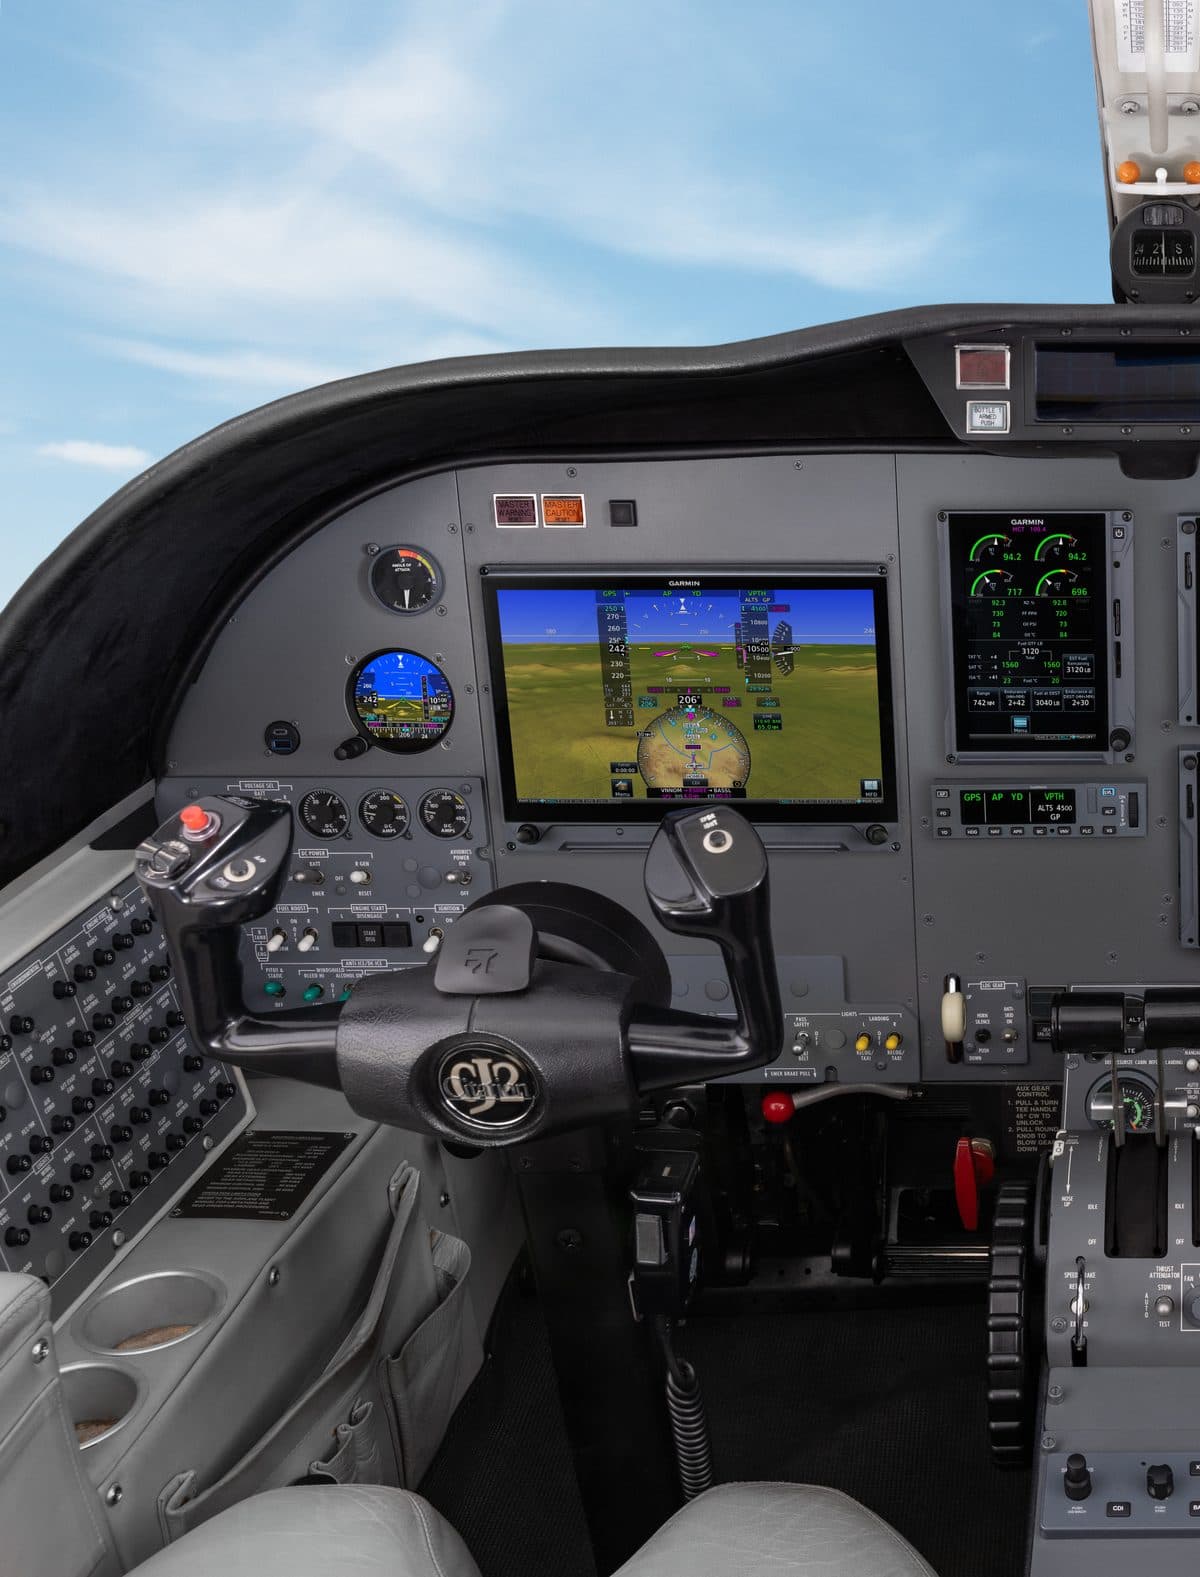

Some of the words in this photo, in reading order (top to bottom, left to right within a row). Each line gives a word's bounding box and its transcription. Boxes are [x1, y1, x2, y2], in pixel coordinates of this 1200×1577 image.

[1175, 243, 1183, 254] S
[975, 405, 996, 413] BOTTLE
[1003, 553, 1022, 561] 94.2
[1068, 553, 1087, 561] 94.2
[1007, 588, 1022, 596] 717
[1072, 588, 1087, 596] 696
[678, 696, 700, 704] 206°
[1008, 699, 1025, 707] 2+42
[1072, 699, 1089, 707] 2+30
[964, 793, 981, 801] GPS
[992, 793, 1003, 801] AP
[1011, 793, 1023, 801] YD
[1044, 792, 1064, 800] VPTH
[1050, 813, 1061, 821] GP
[450, 1058, 524, 1115] CJ2
